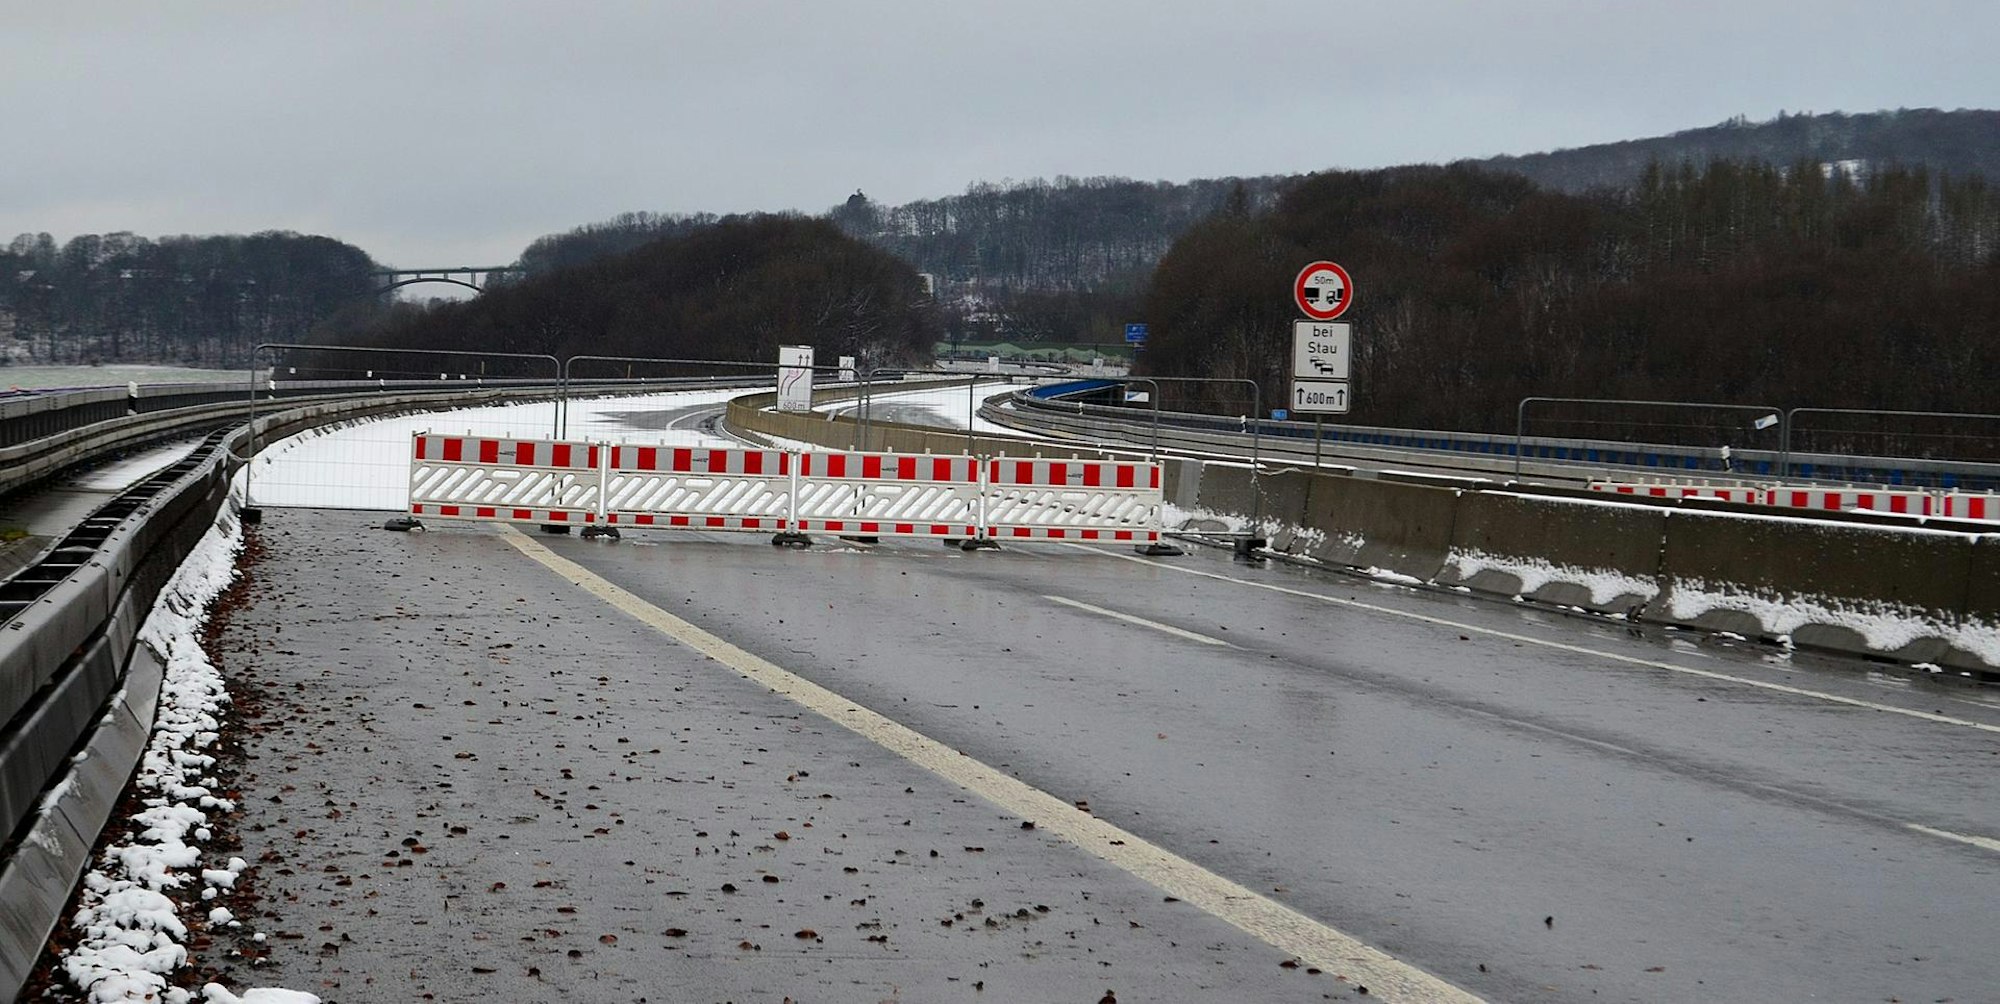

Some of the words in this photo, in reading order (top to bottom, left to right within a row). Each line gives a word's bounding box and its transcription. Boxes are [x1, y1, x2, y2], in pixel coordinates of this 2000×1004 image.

[1314, 276, 1334, 285] 50m
[1313, 325, 1333, 338] bei
[1308, 341, 1337, 354] Stau
